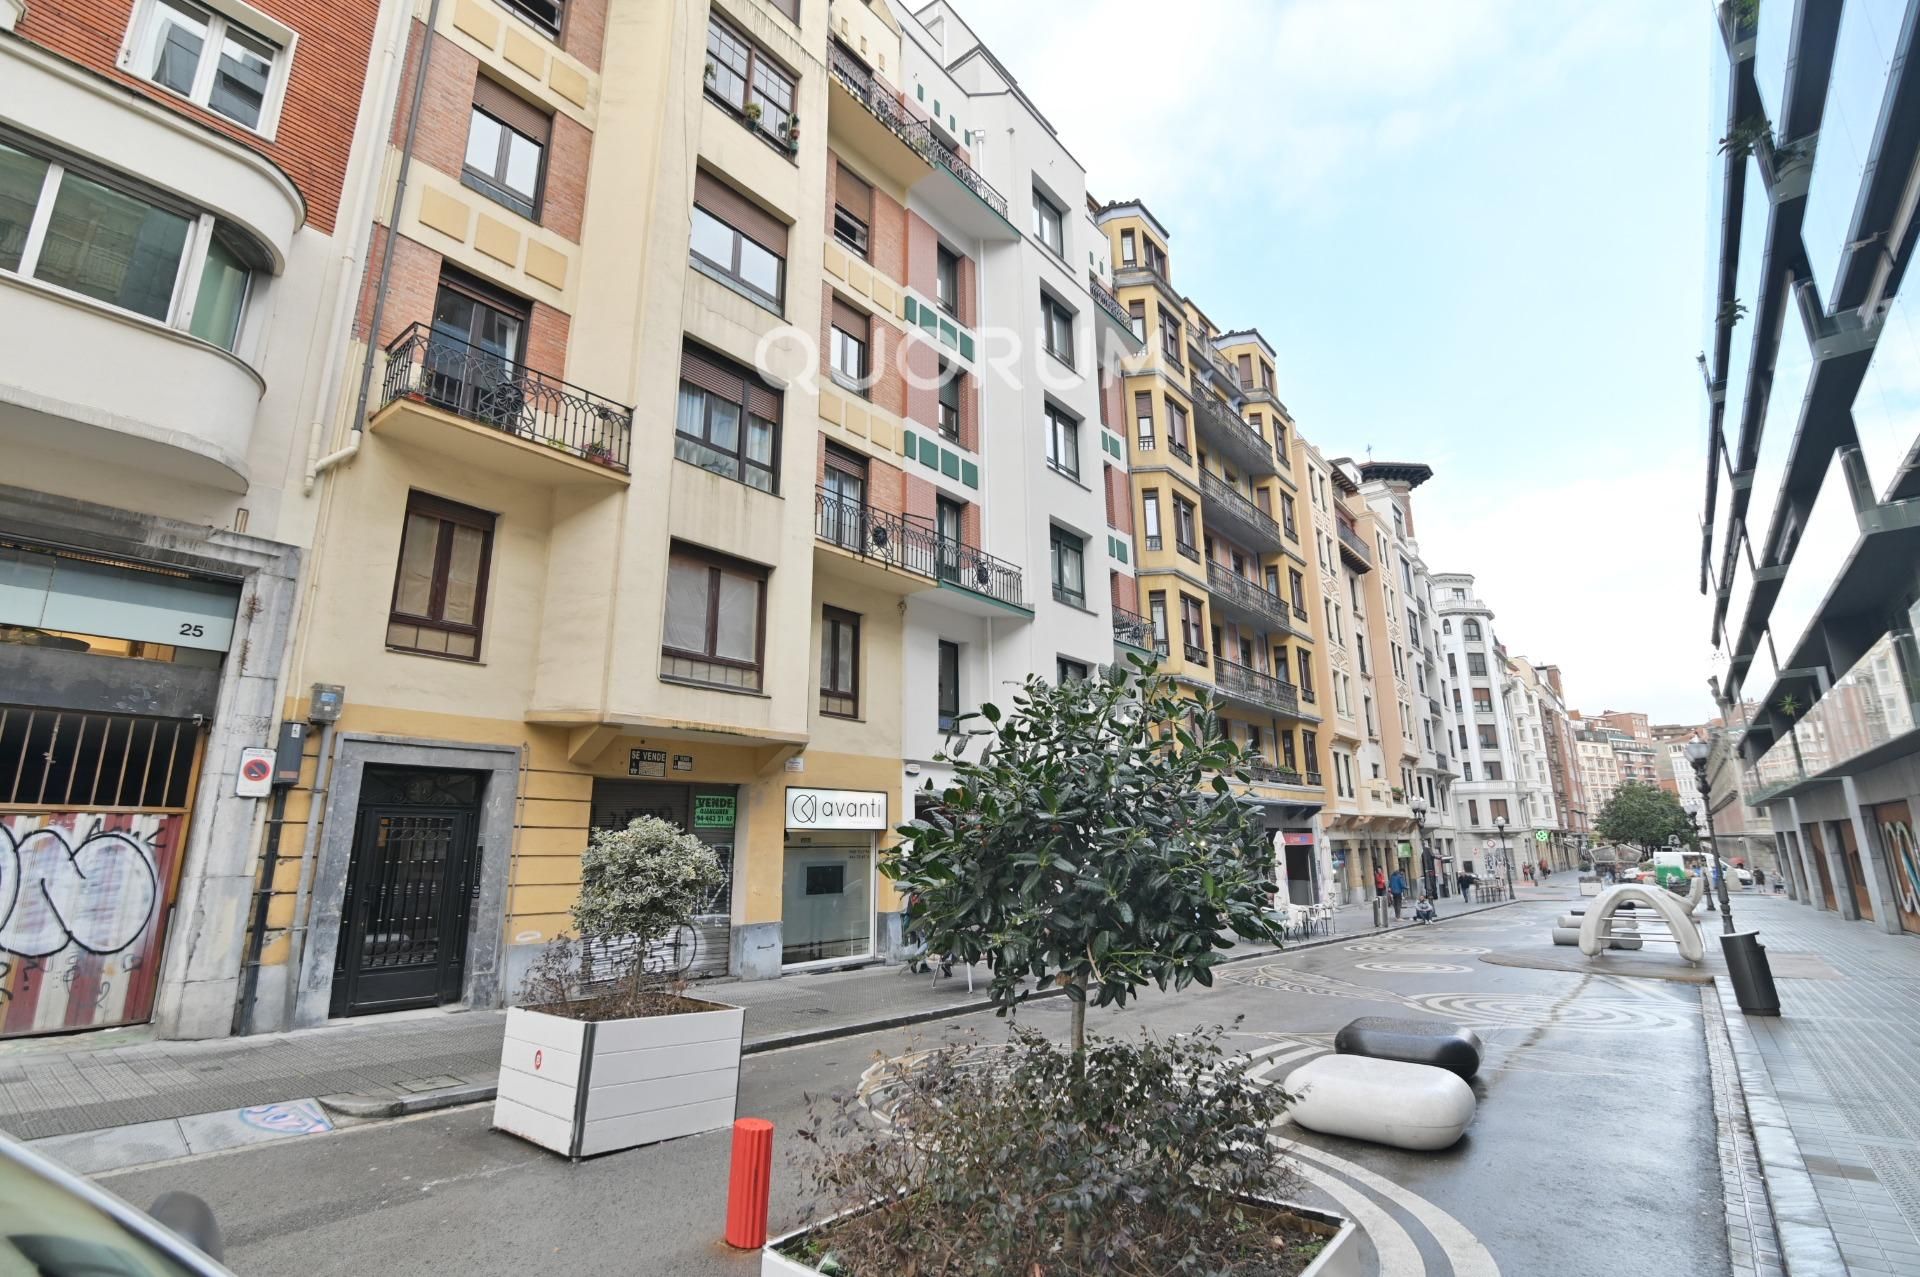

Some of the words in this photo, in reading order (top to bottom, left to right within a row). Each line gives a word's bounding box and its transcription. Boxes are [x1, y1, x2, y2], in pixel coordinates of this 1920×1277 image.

[179, 623, 204, 638] 25
[631, 750, 641, 760] SE
[642, 751, 666, 762] VENDE
[698, 797, 733, 808] VENDE
[822, 798, 881, 818] avanti
